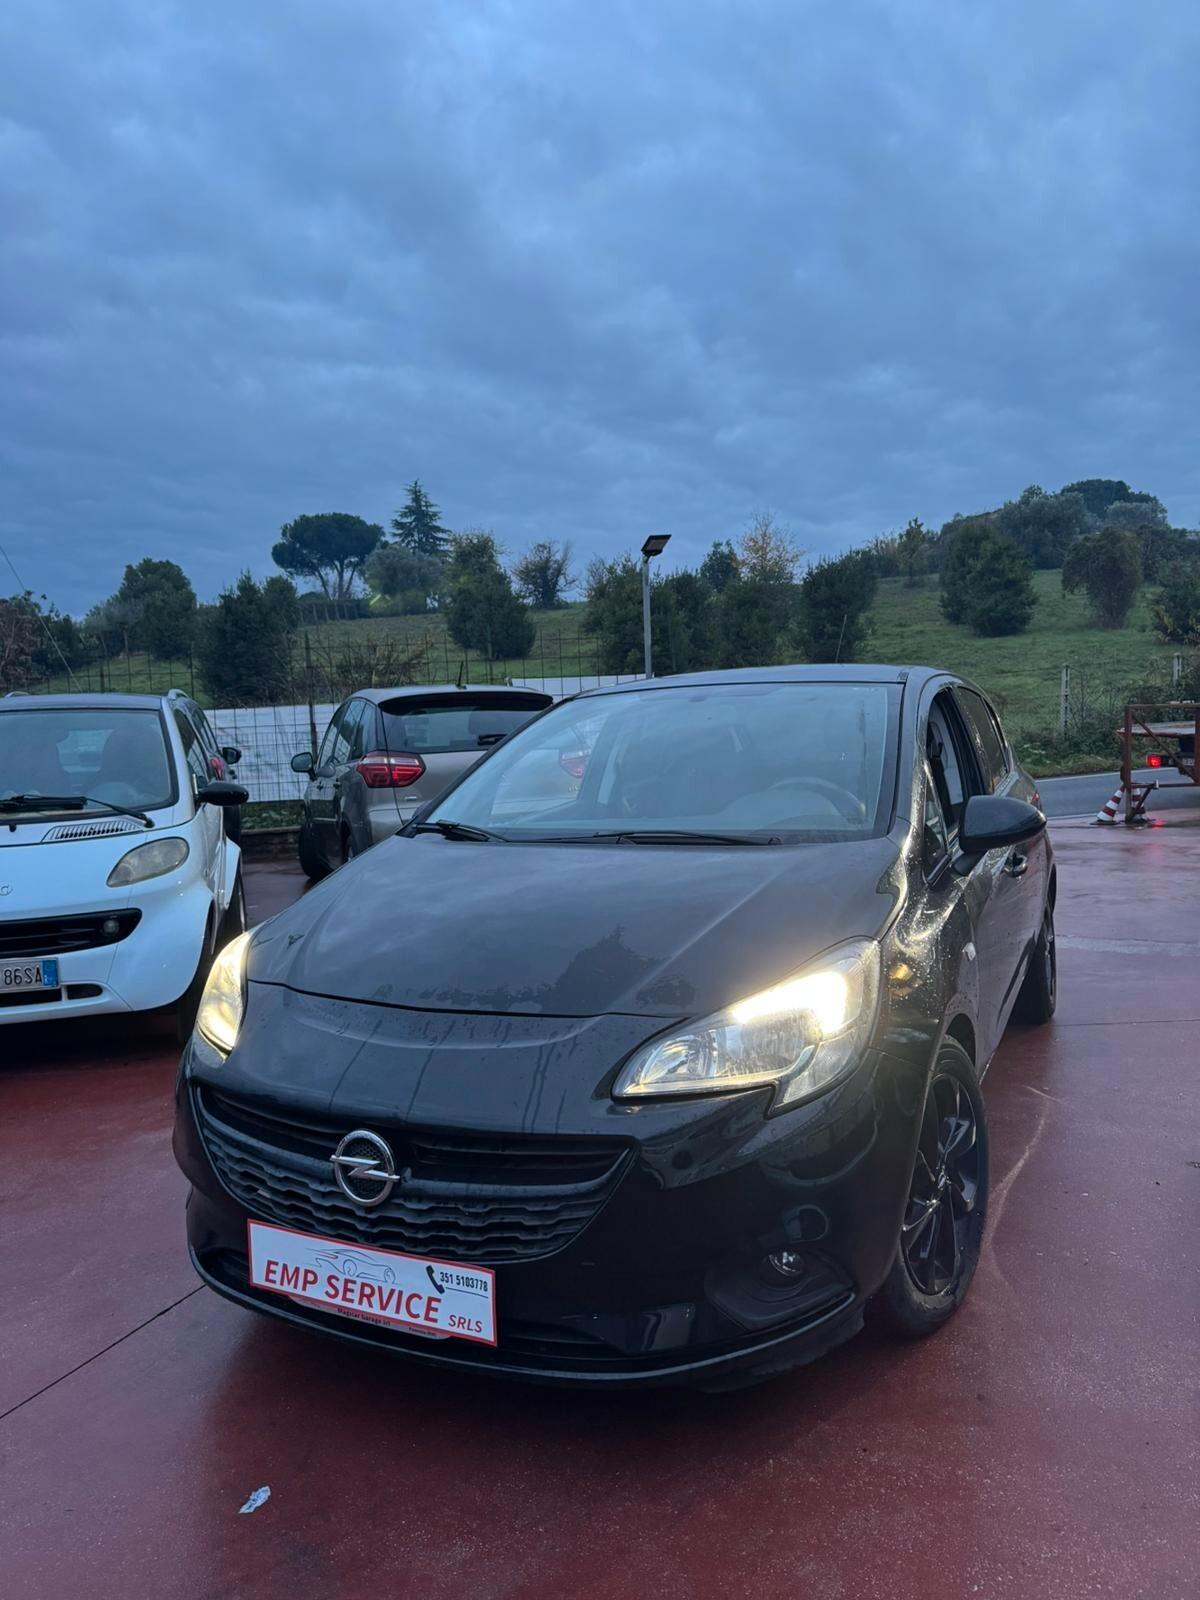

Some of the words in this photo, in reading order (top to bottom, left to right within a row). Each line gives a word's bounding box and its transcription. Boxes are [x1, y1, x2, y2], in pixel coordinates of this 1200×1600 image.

[264, 1259, 318, 1292] EMP
[325, 1274, 442, 1323] SERVICE
[448, 1314, 483, 1333] SRLS
[440, 1271, 454, 1285] 351
[456, 1274, 488, 1292] 5103778
